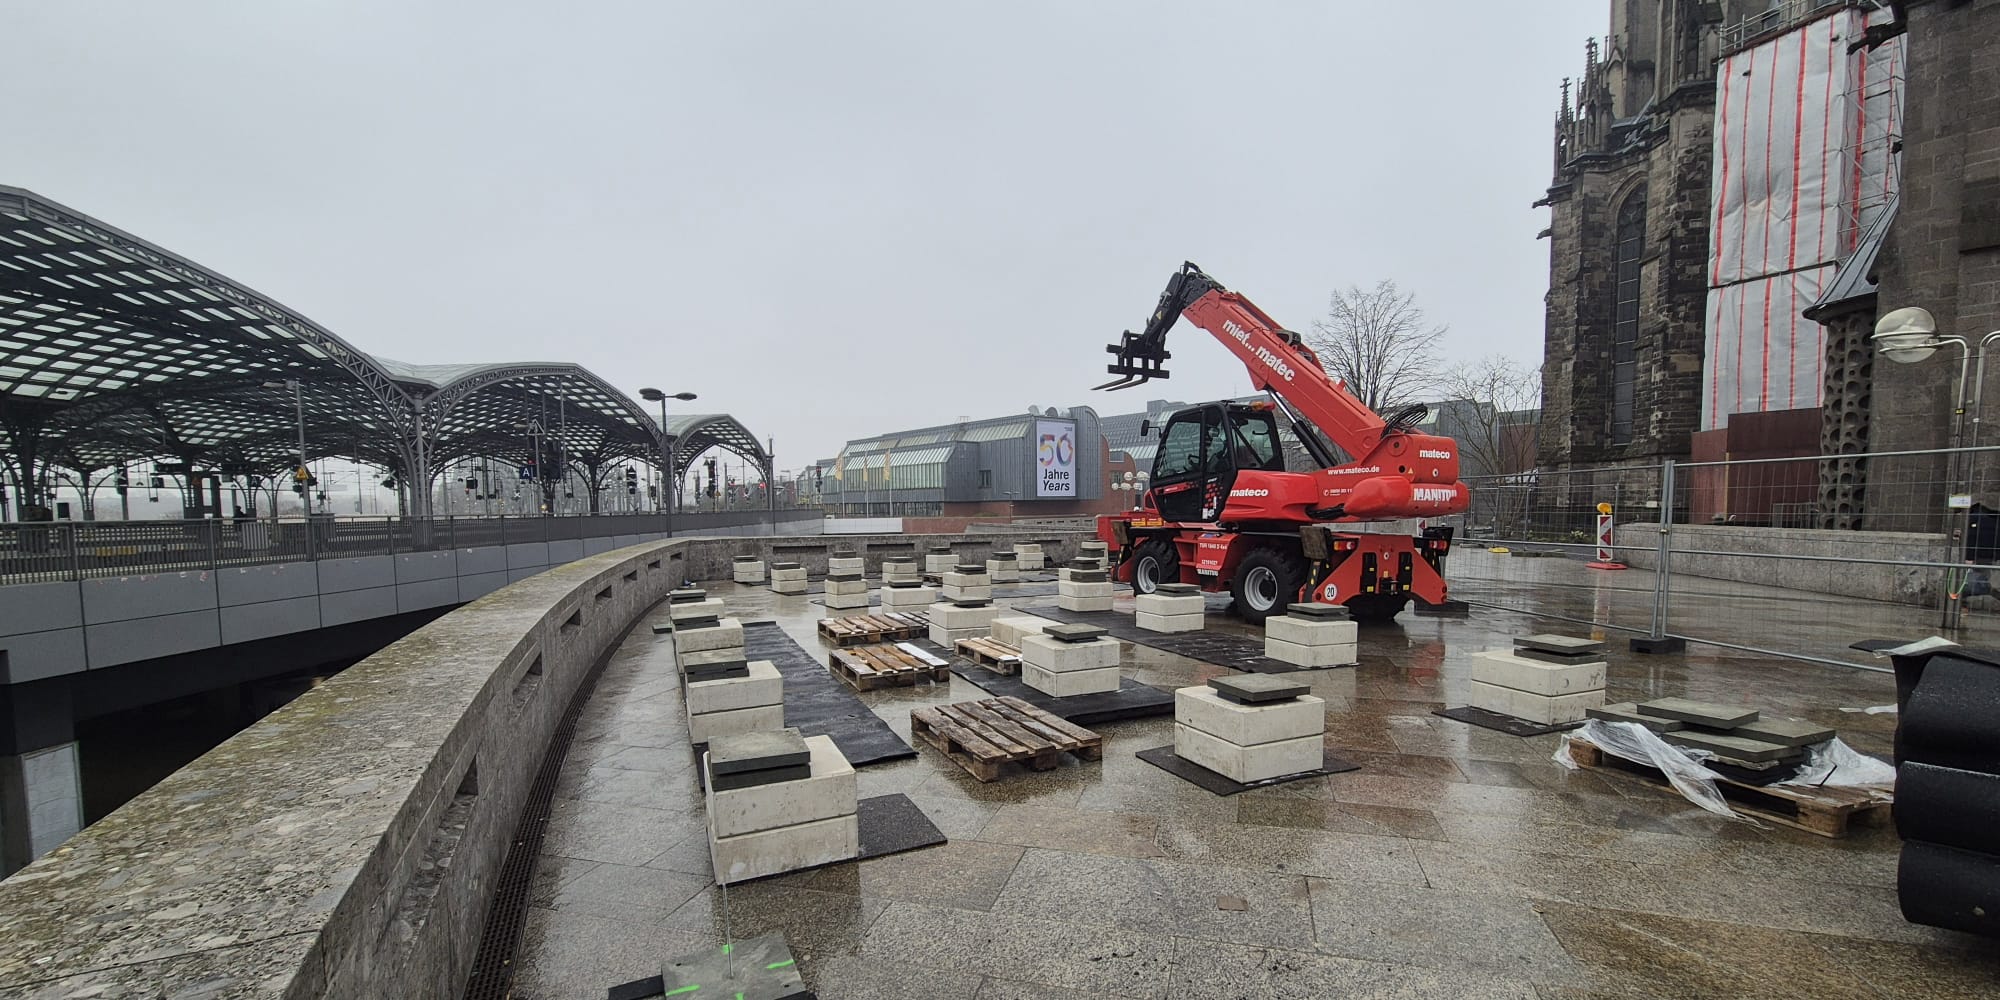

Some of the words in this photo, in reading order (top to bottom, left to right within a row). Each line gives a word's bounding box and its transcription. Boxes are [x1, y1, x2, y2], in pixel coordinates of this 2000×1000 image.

[1255, 346, 1295, 381] matec
[1039, 433, 1073, 467] 50
[1419, 449, 1450, 459] mateco
[1043, 468, 1069, 480] Jahre
[1327, 465, 1380, 476] www.mateco.de
[1043, 480, 1070, 491] Years
[1230, 488, 1268, 497] mateco
[1326, 587, 1335, 598] 20
